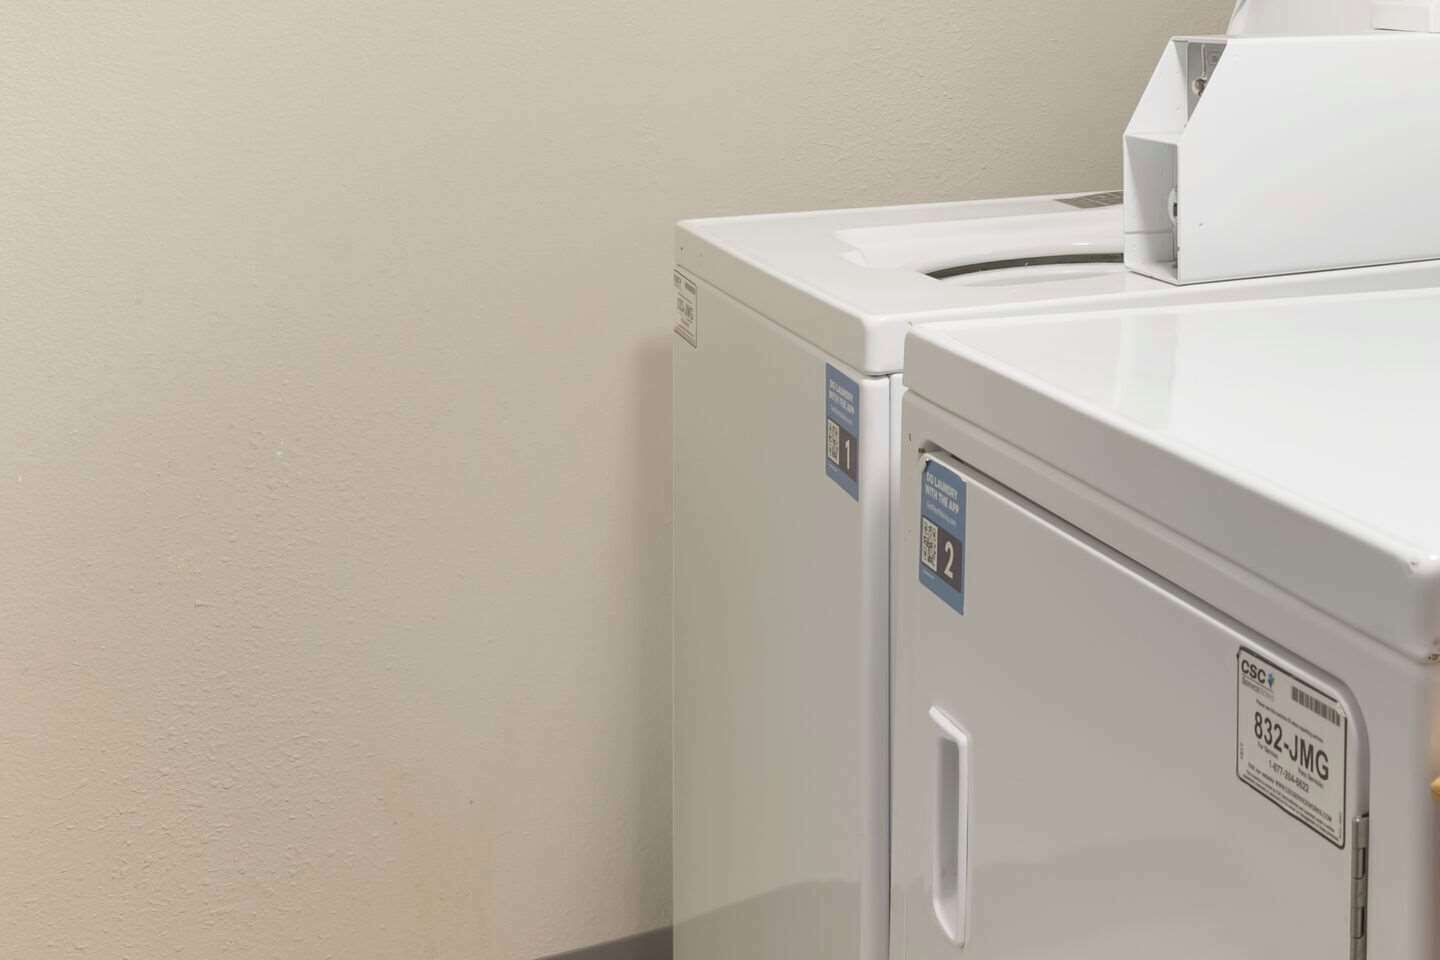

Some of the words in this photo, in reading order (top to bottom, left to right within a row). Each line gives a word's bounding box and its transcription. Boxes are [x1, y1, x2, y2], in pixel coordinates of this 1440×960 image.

[844, 439, 851, 470] 1
[944, 541, 955, 578] 2
[1241, 659, 1266, 684] CSC
[1254, 711, 1329, 781] 832-JMG
